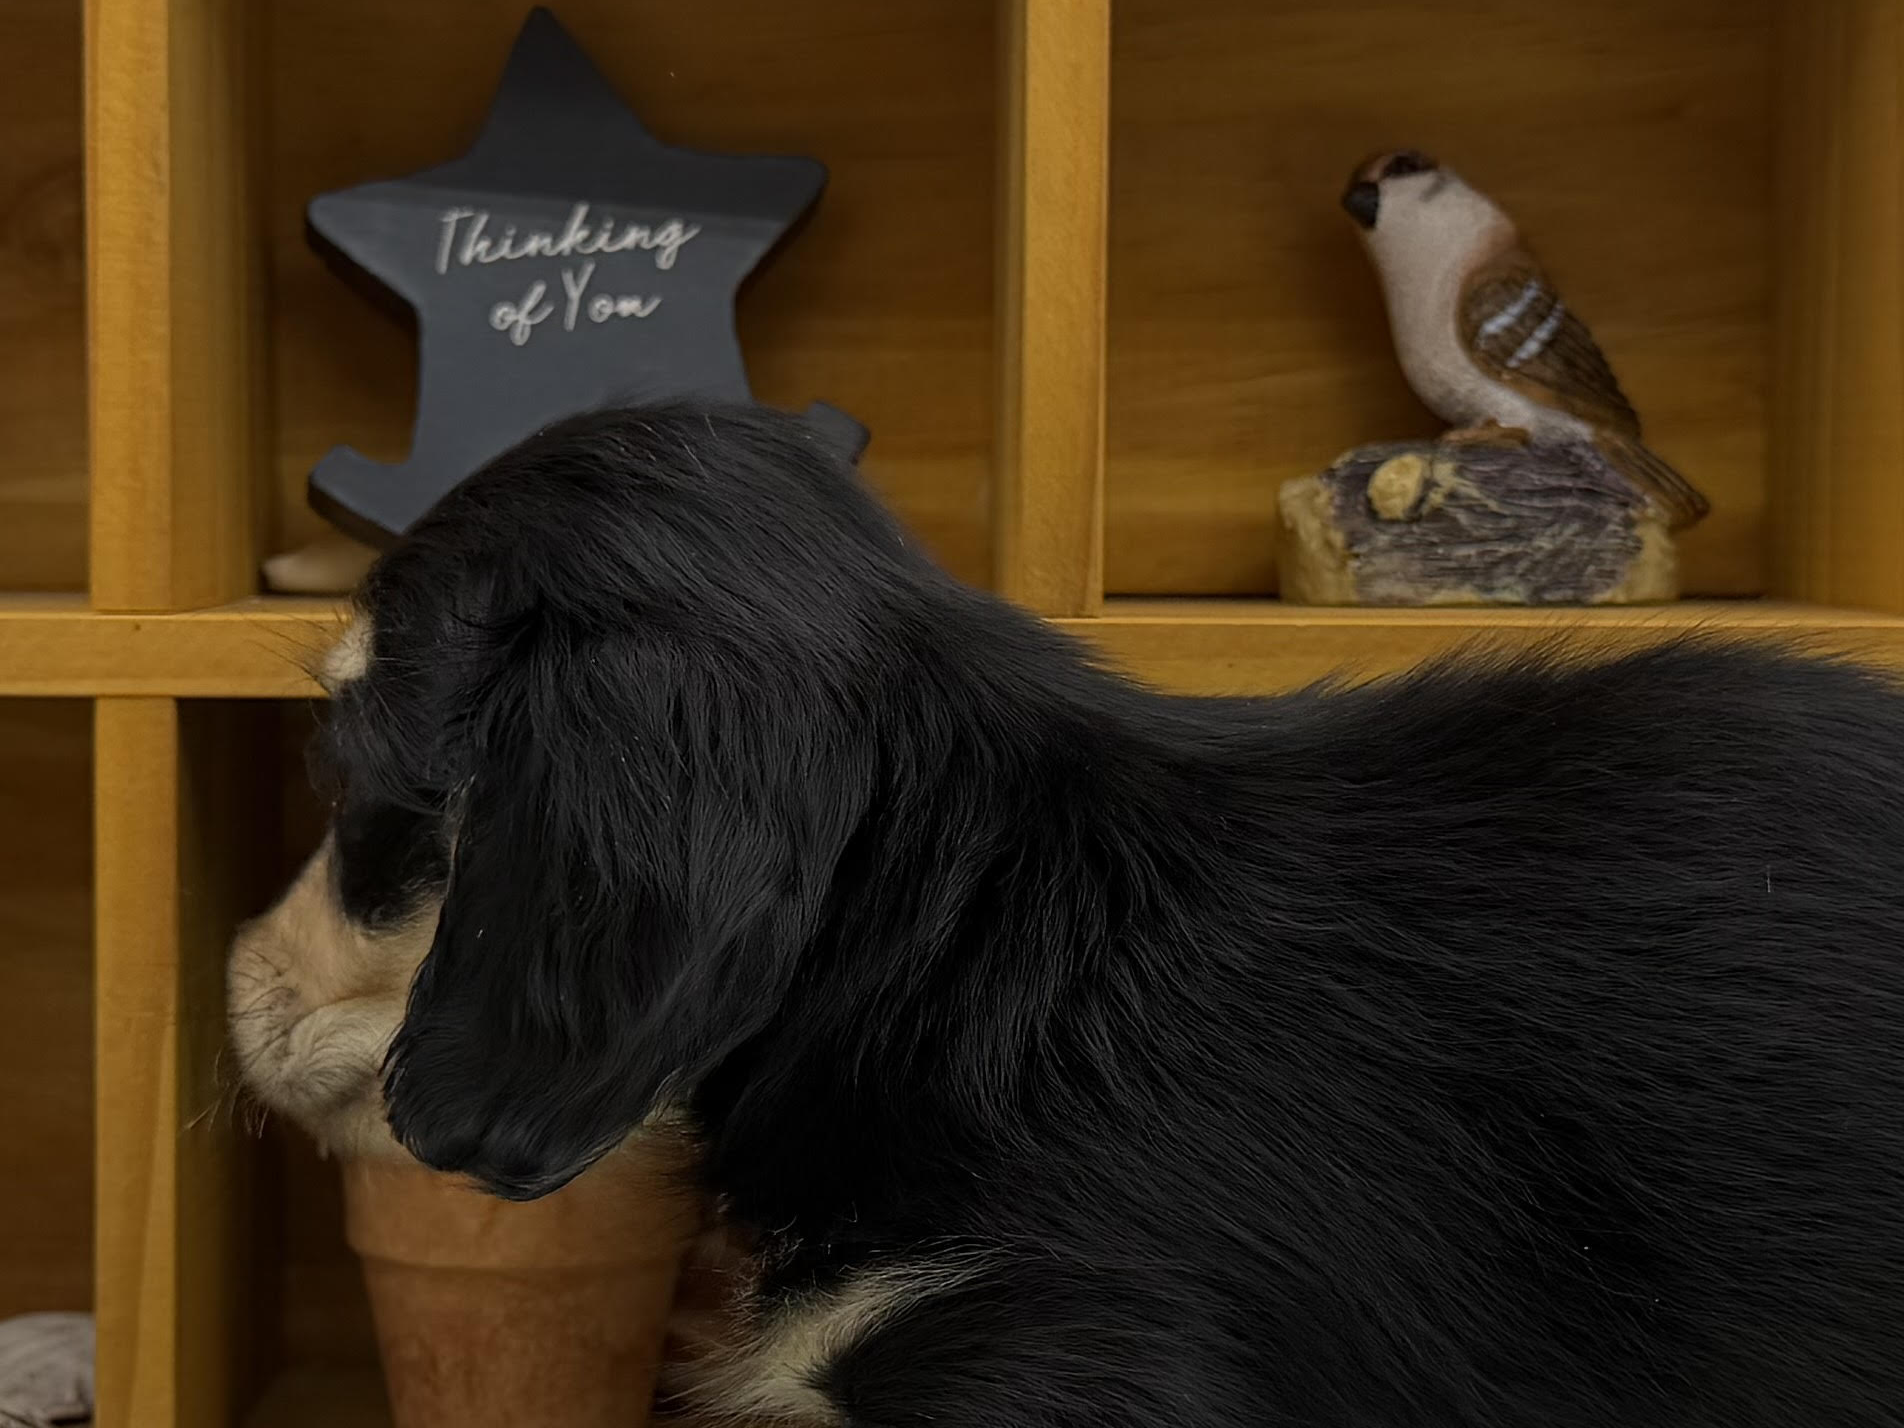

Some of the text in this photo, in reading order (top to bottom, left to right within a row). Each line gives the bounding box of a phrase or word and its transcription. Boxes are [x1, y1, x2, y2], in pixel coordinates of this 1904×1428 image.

[434, 200, 702, 275] Thinking
[488, 258, 664, 347] of You
